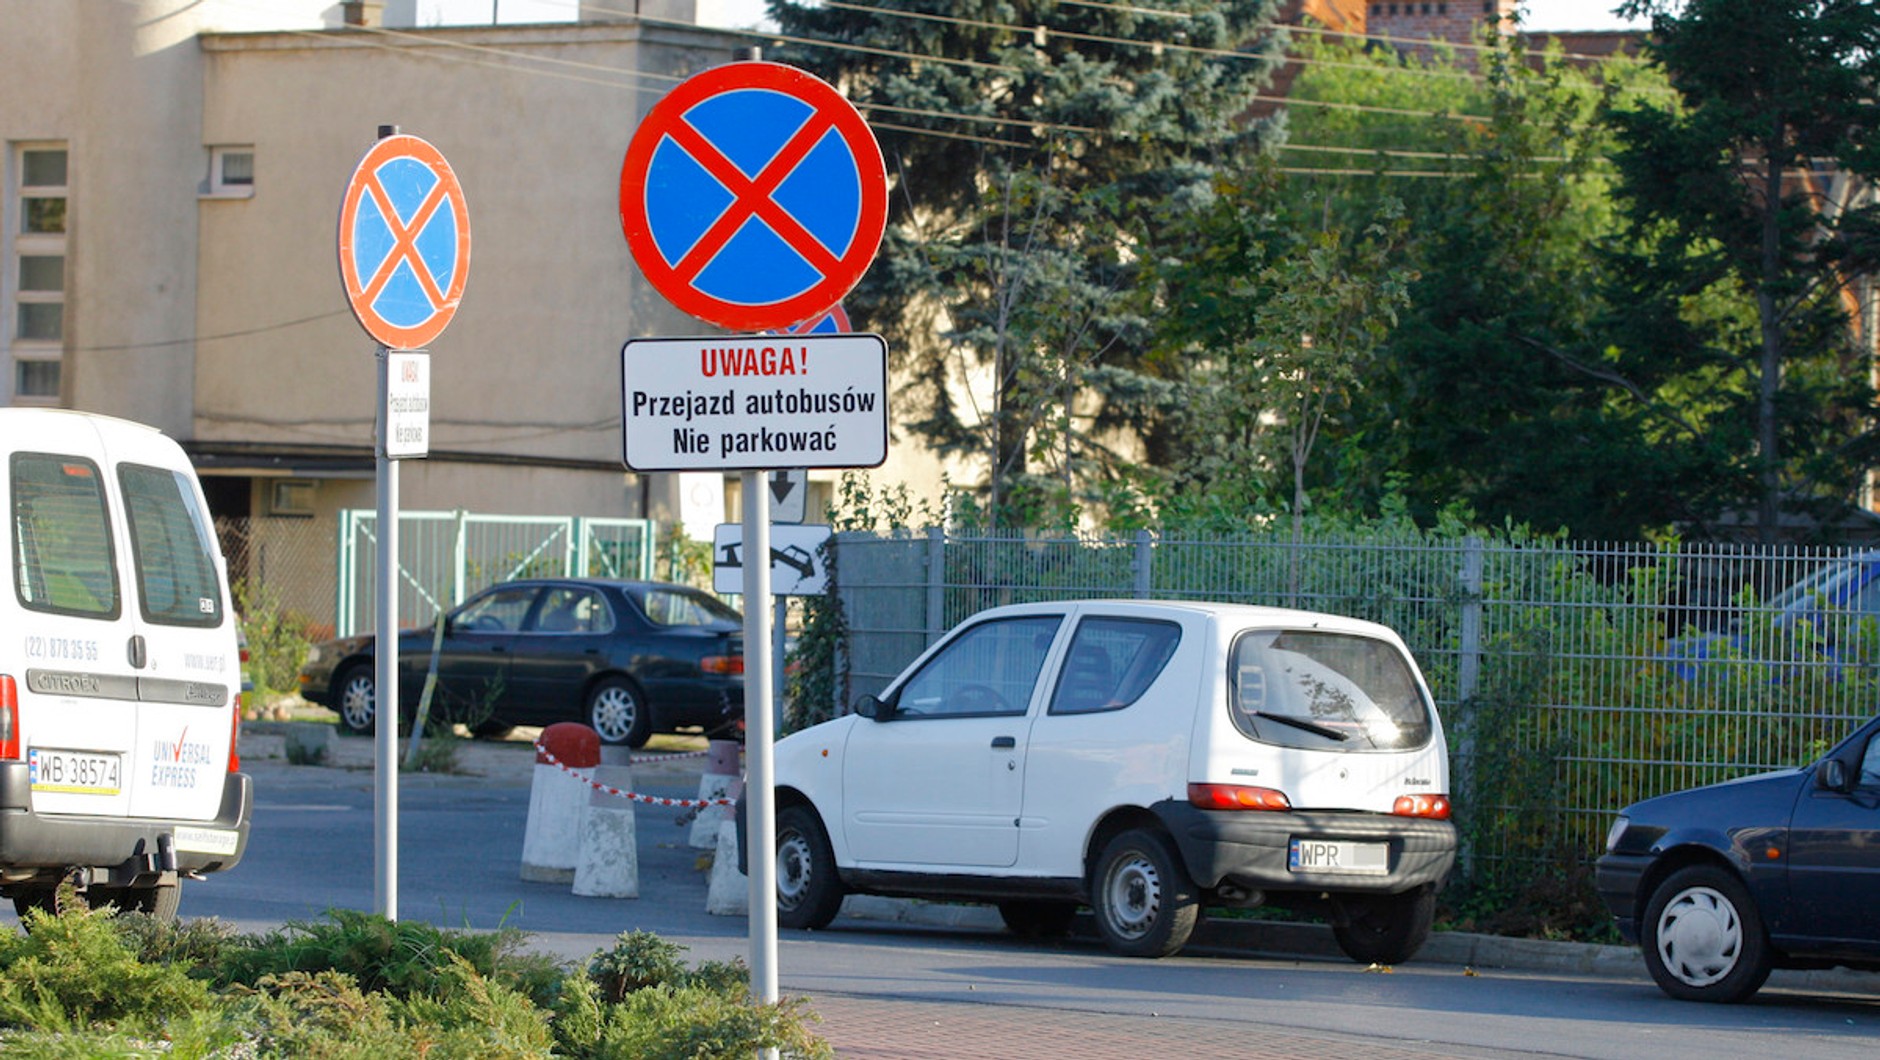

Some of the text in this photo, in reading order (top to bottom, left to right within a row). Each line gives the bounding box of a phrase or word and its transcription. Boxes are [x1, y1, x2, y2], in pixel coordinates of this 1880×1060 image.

[701, 347, 808, 377] UWAGA!
[633, 386, 876, 421] Przejazd autobusów
[673, 424, 837, 458] Nie parkować
[25, 636, 46, 660] (22)
[50, 638, 68, 658] 878
[71, 639, 83, 660] 35
[153, 725, 211, 764] UNIVERSAL
[40, 755, 117, 787] WB 38574
[151, 765, 197, 788] EXPRESS
[1301, 843, 1339, 866] WPR
